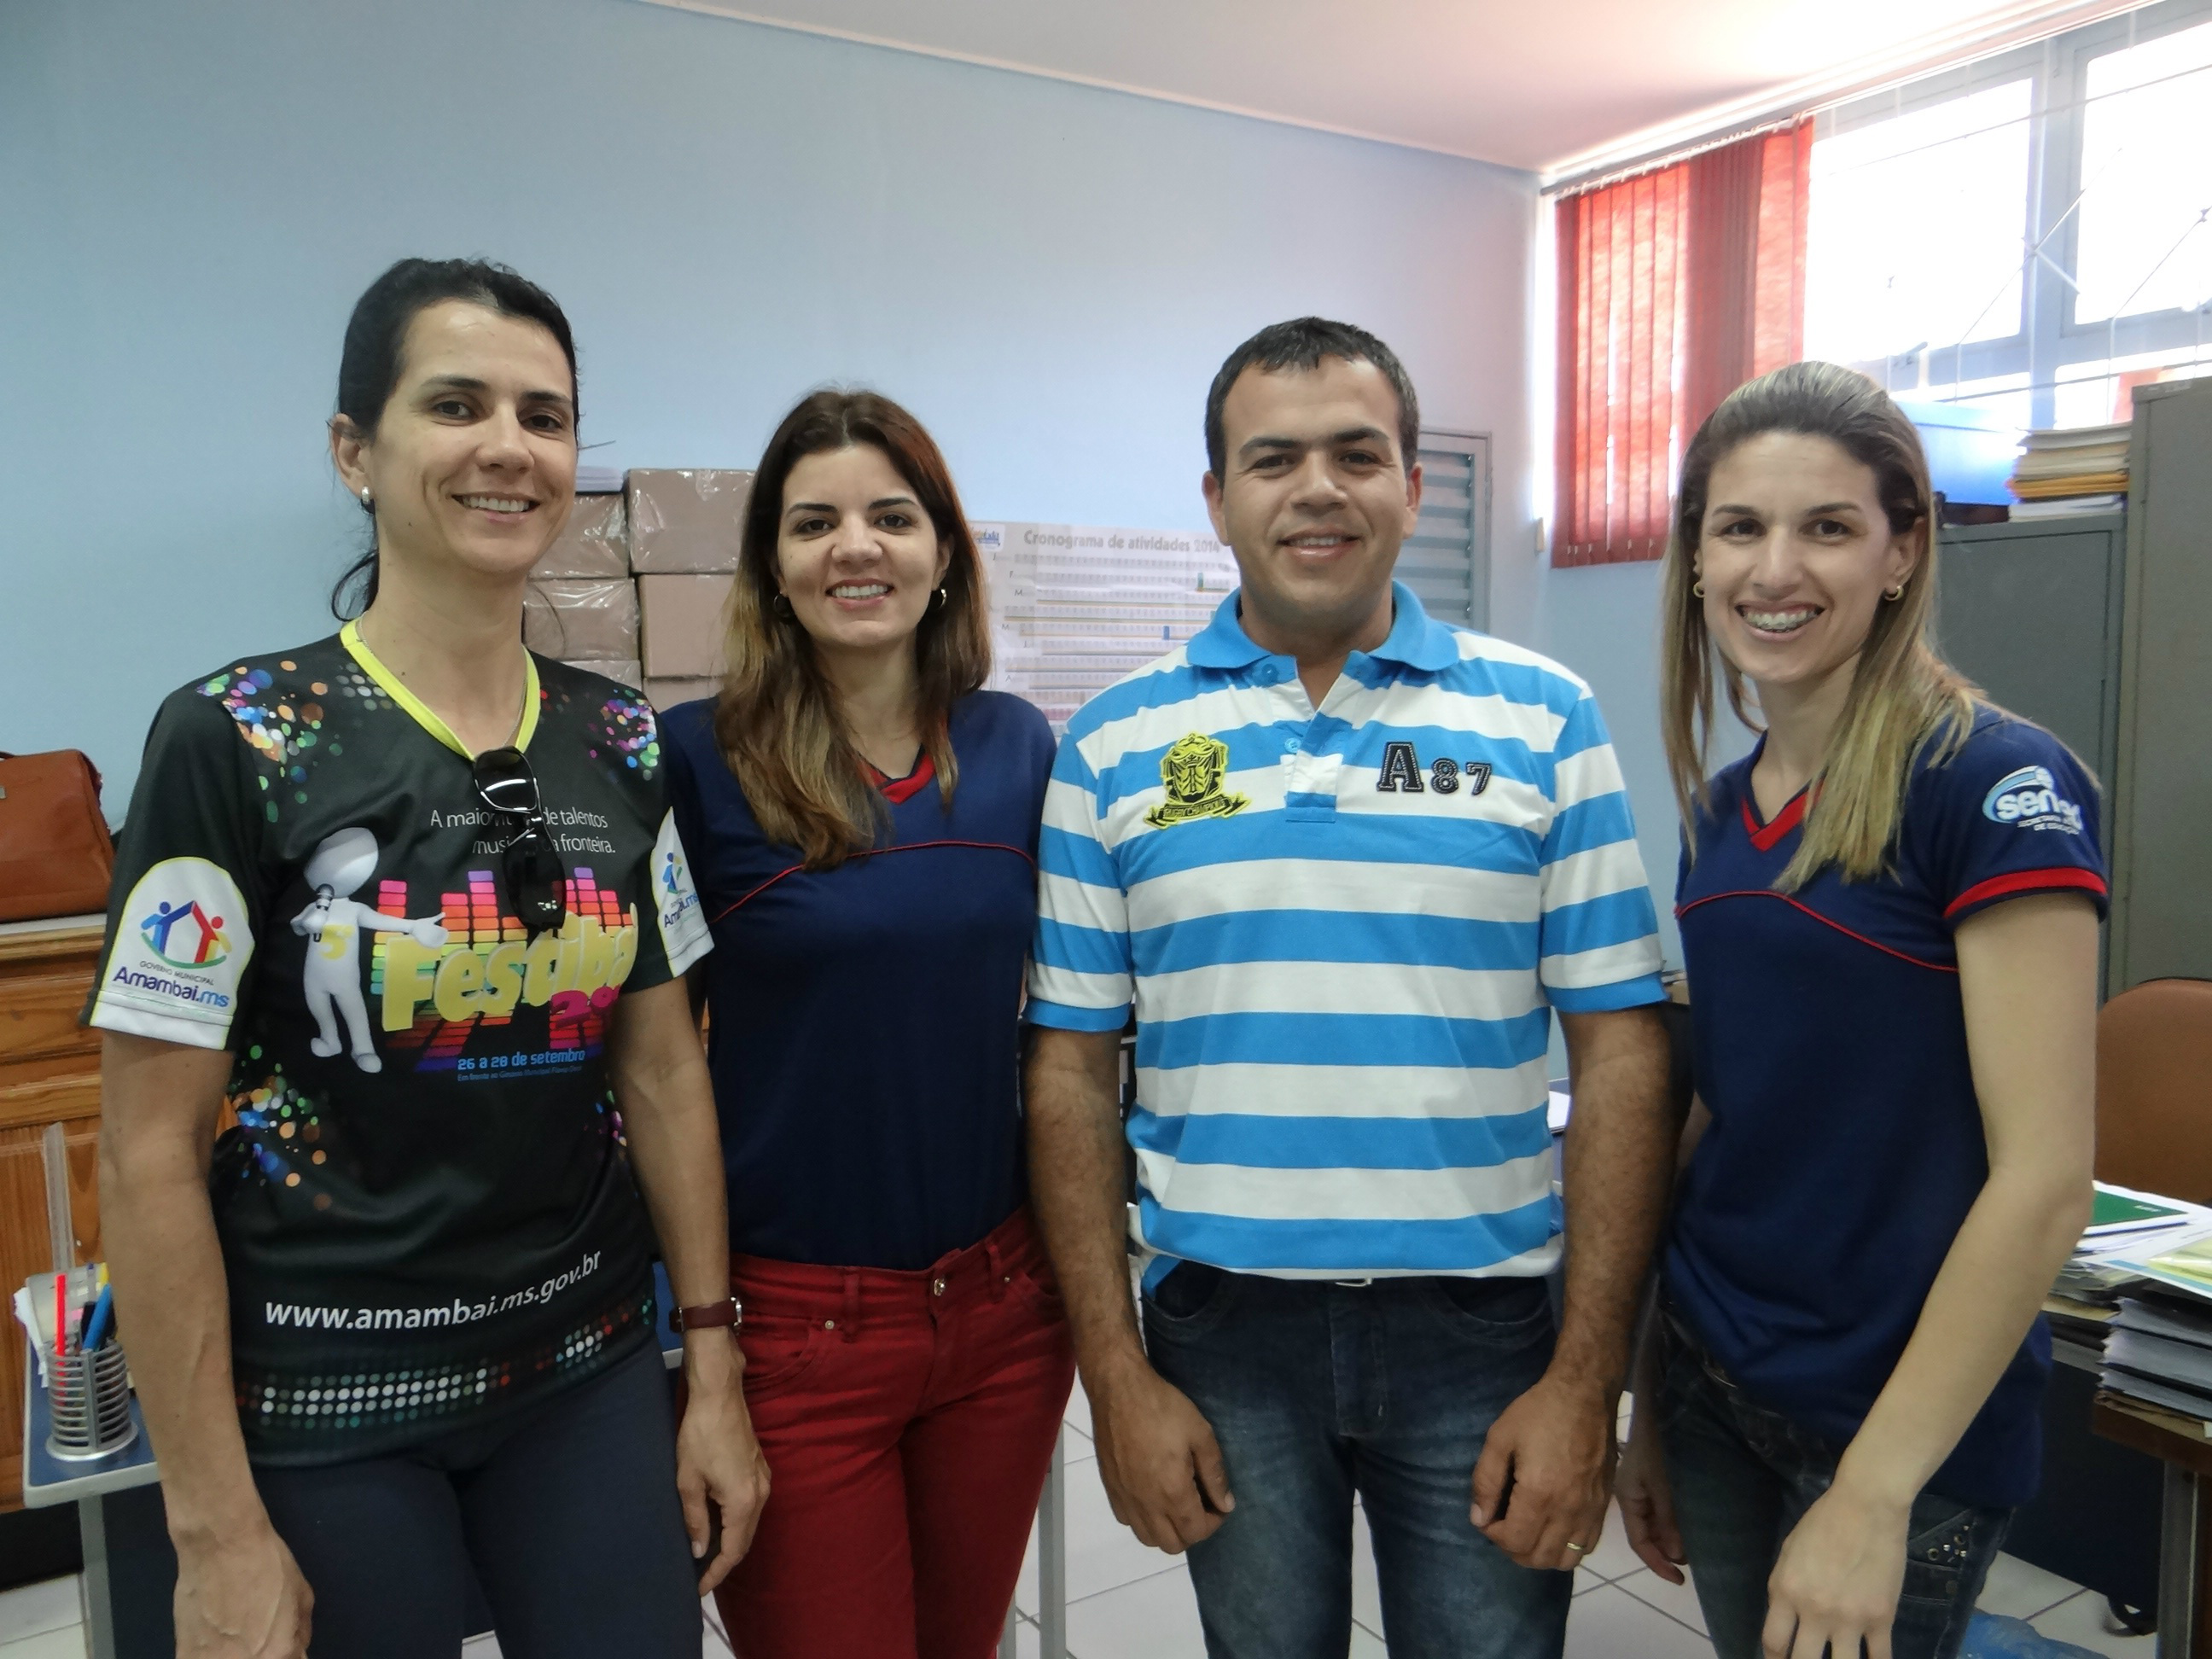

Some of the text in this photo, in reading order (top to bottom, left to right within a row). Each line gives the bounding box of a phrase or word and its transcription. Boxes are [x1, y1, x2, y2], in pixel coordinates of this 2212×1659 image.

[1023, 529, 1103, 550] Cronograma
[1107, 533, 1125, 550] de
[1127, 534, 1190, 553] atividades
[1376, 741, 1492, 795] A 87
[430, 809, 443, 828] A
[562, 806, 609, 829] talentos
[561, 833, 617, 854] fronteira.
[139, 960, 215, 987] GOVERNO MUNICIPAL
[113, 966, 230, 1008] Amambai.ms
[457, 1047, 585, 1071] 26 a 28 de setembro
[265, 1250, 601, 1330] www.amambai.ms.gov.br
